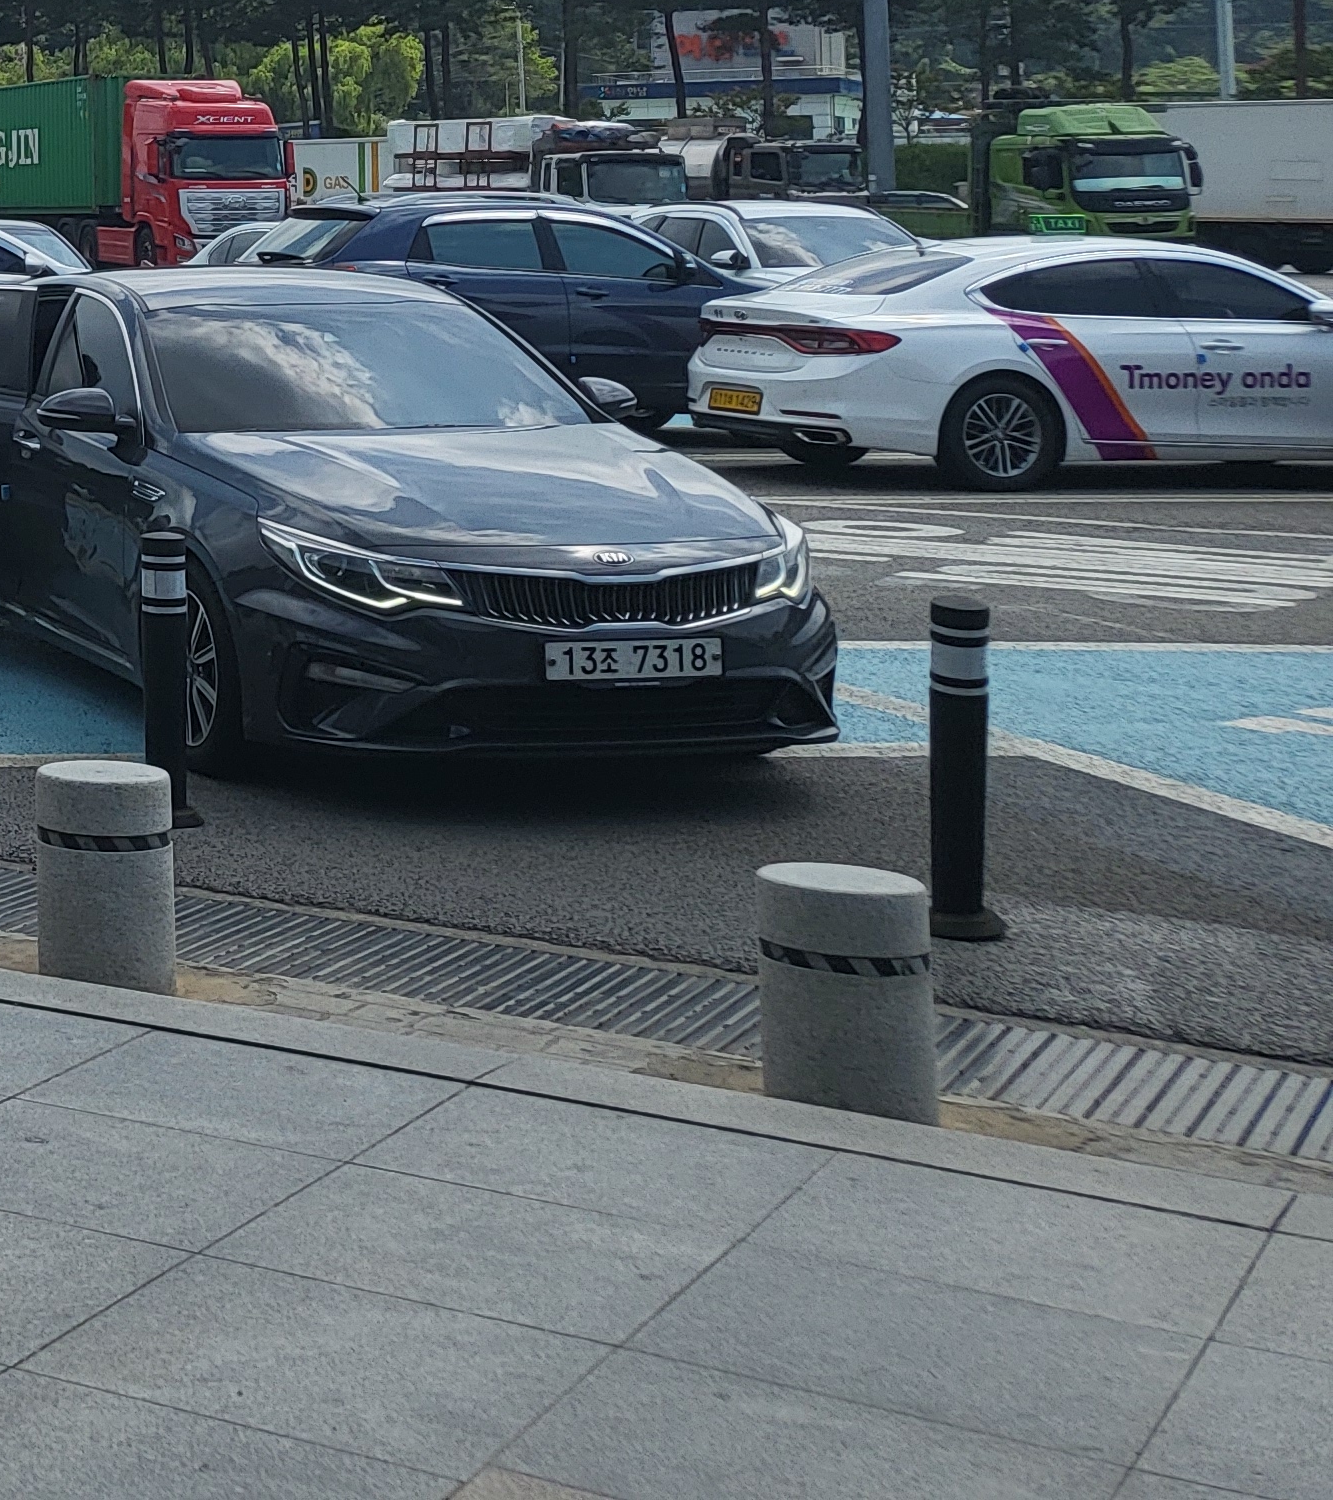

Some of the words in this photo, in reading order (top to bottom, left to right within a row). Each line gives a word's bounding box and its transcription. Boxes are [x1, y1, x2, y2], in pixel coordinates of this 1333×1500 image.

[192, 115, 256, 125] XCIENT
[324, 176, 350, 190] GAS
[1049, 218, 1080, 230] TAXI
[1119, 364, 1233, 395] Tmoney
[1241, 363, 1312, 389] onda
[599, 552, 628, 563] KIA
[562, 646, 619, 675] 13조
[633, 642, 707, 673] 7318
